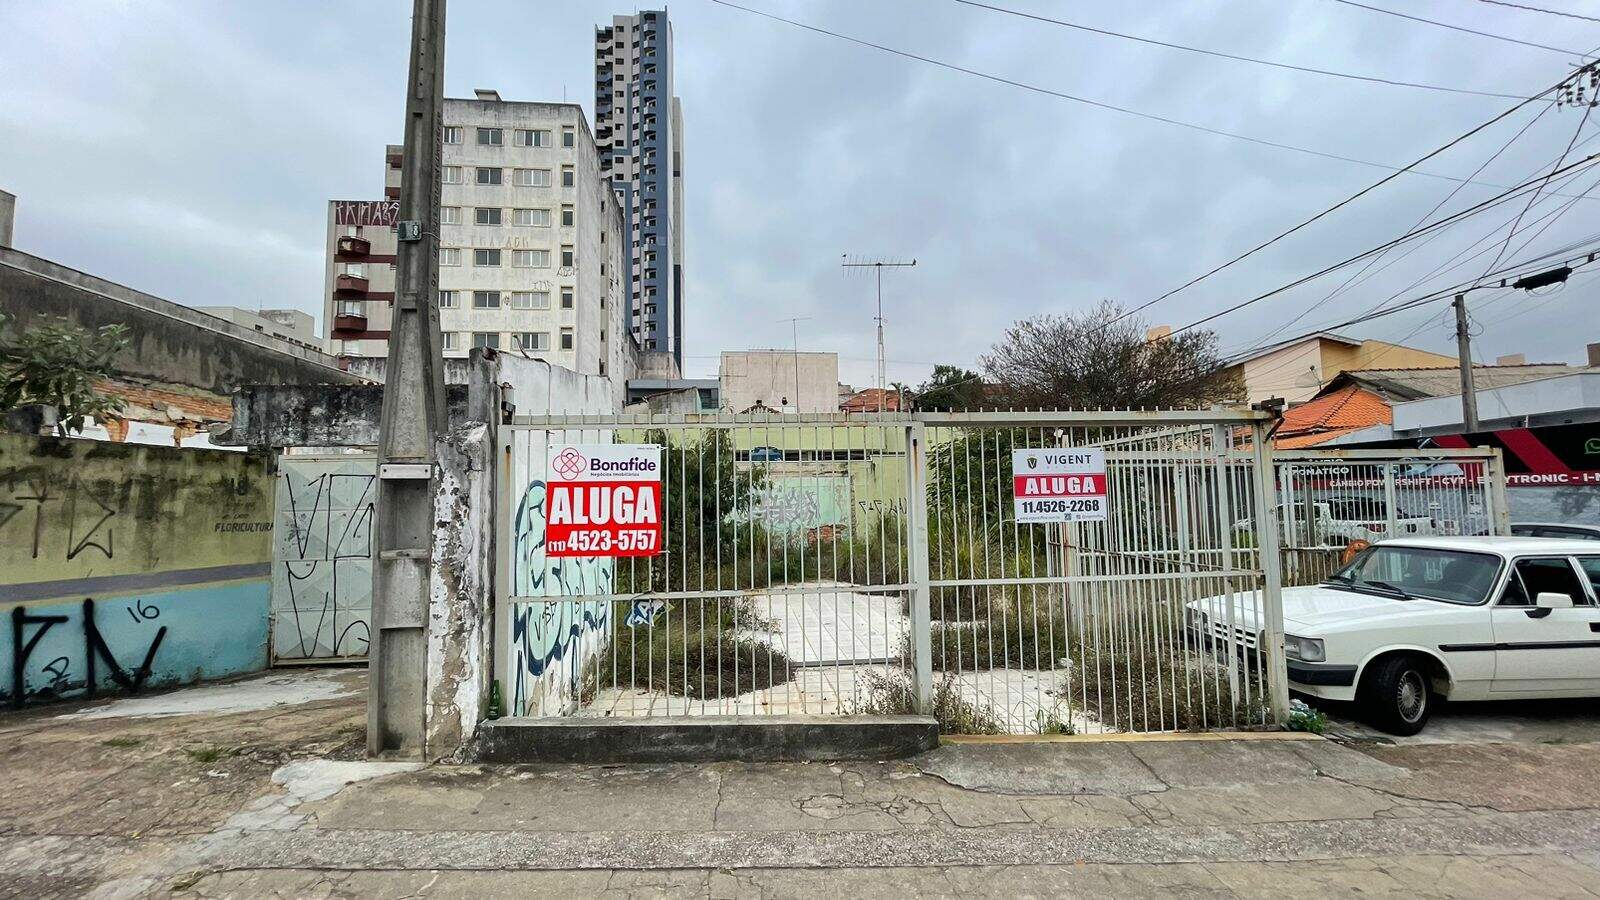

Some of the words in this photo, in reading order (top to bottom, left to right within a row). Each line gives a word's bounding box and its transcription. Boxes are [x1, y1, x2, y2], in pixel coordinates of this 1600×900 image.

[590, 457, 656, 471] Bonafide
[1045, 455, 1092, 465] VIGENT
[1025, 476, 1096, 495] ALUGA
[1366, 477, 1432, 487] POWRSHIFT
[1477, 473, 1569, 485] EYTRONIC
[549, 486, 658, 525] ALUGA
[1022, 500, 1100, 513] 11.4526-2268
[567, 530, 657, 551] 4523-5757
